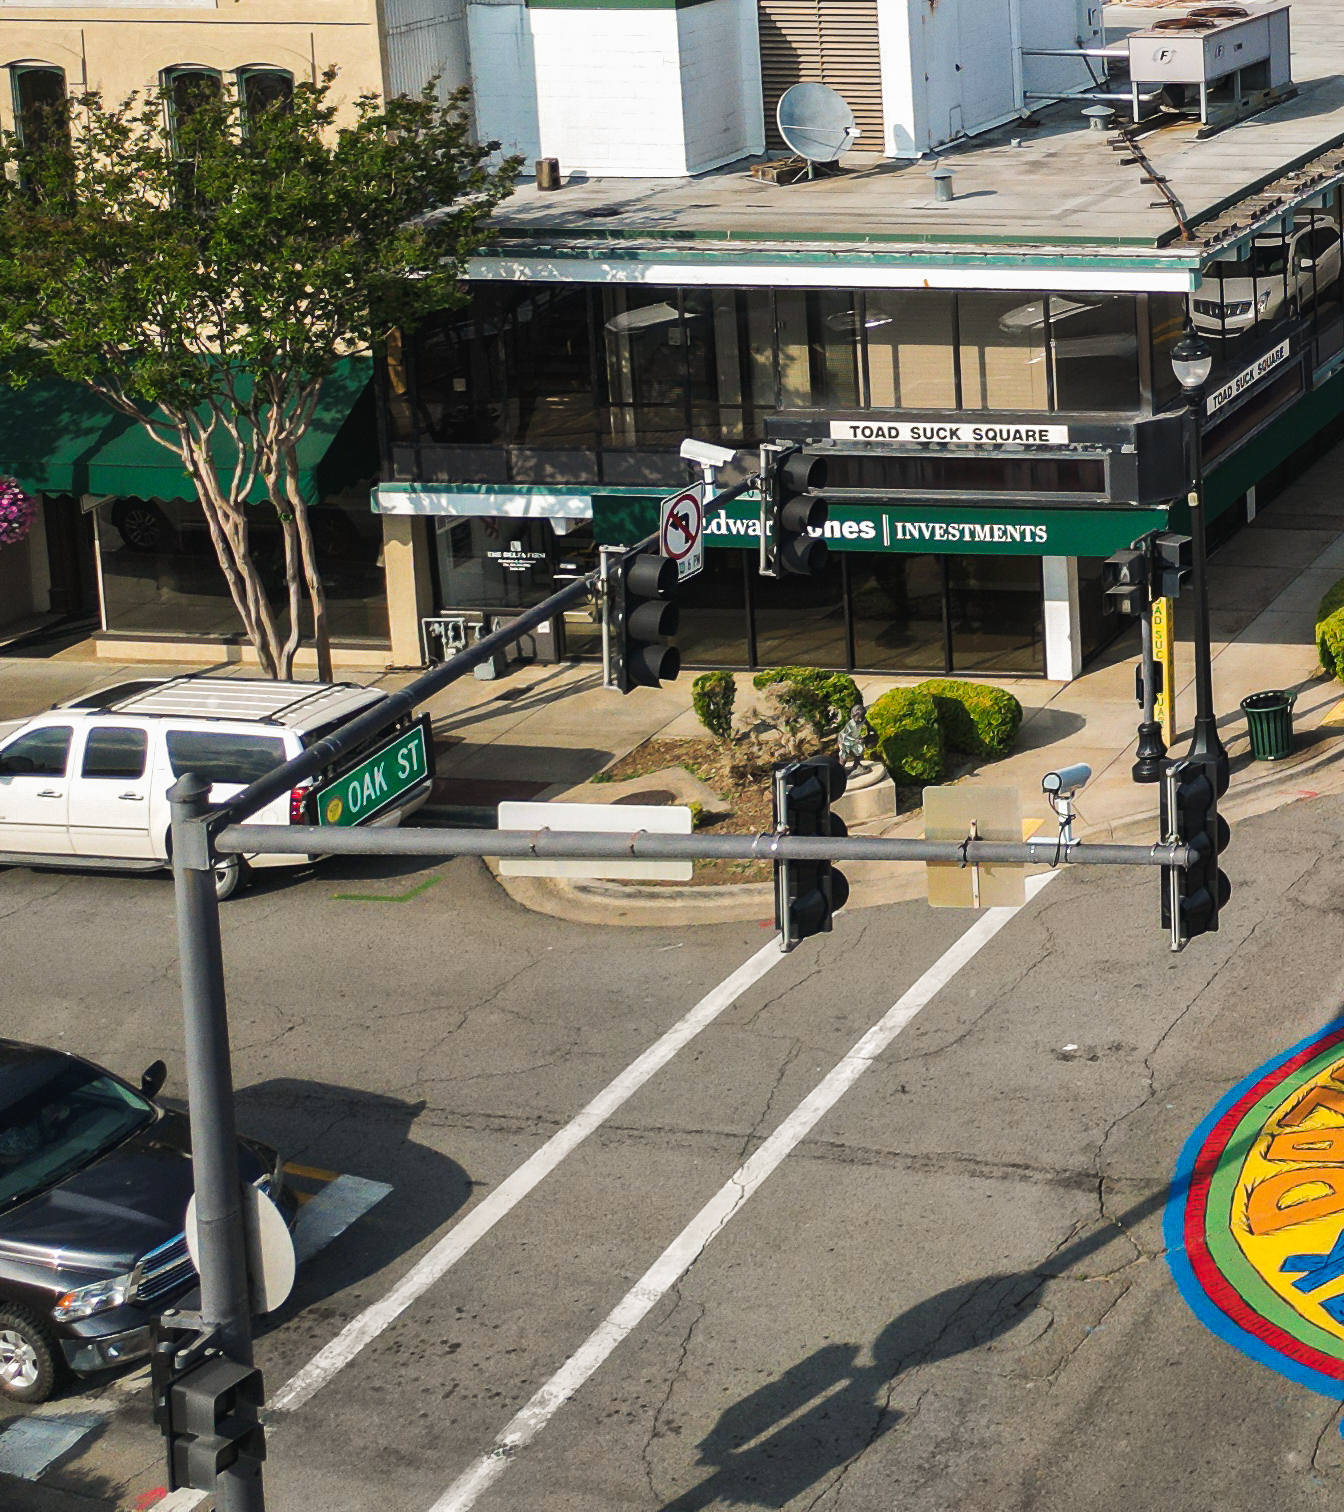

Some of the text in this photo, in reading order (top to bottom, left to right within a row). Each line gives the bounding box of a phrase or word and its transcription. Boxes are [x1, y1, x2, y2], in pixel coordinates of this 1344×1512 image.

[1212, 345, 1285, 409] TOAD SUCK SQUARE
[849, 425, 1050, 443] TOAD SUCK SQUARE
[702, 509, 1048, 543] dwar ones INVESTMENTS
[1154, 630, 1163, 660] SUC
[347, 738, 419, 813] OAK ST
